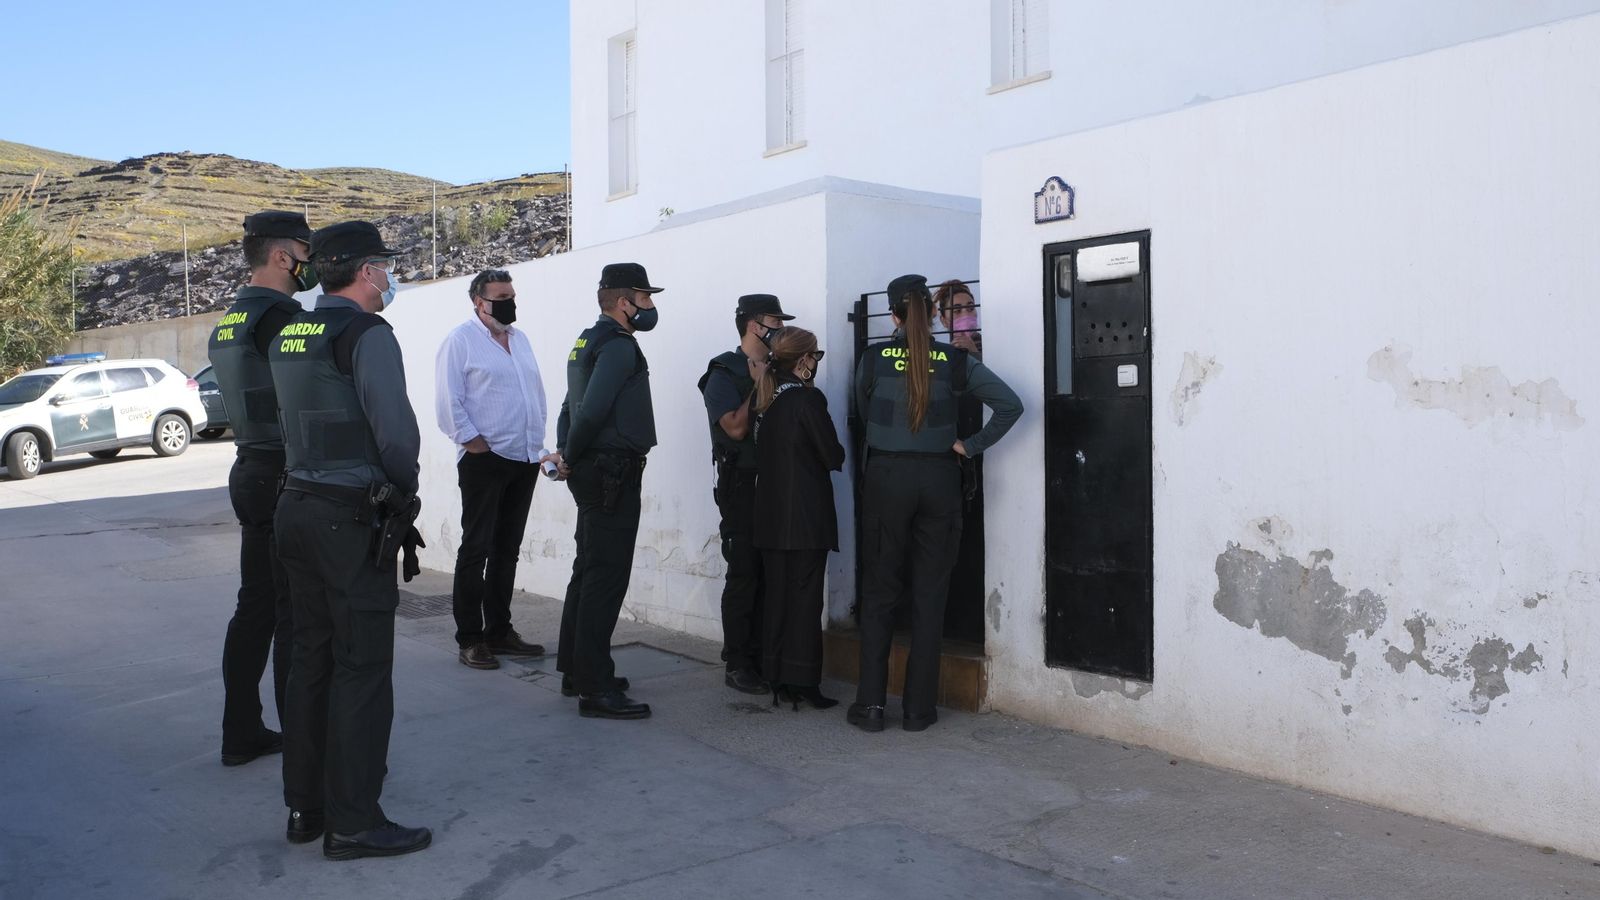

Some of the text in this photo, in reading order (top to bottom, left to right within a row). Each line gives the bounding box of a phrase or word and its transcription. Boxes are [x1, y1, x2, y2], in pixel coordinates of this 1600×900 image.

[217, 327, 235, 342] CIVIL
[280, 322, 326, 337] GUARDIA
[280, 338, 307, 353] CIVIL
